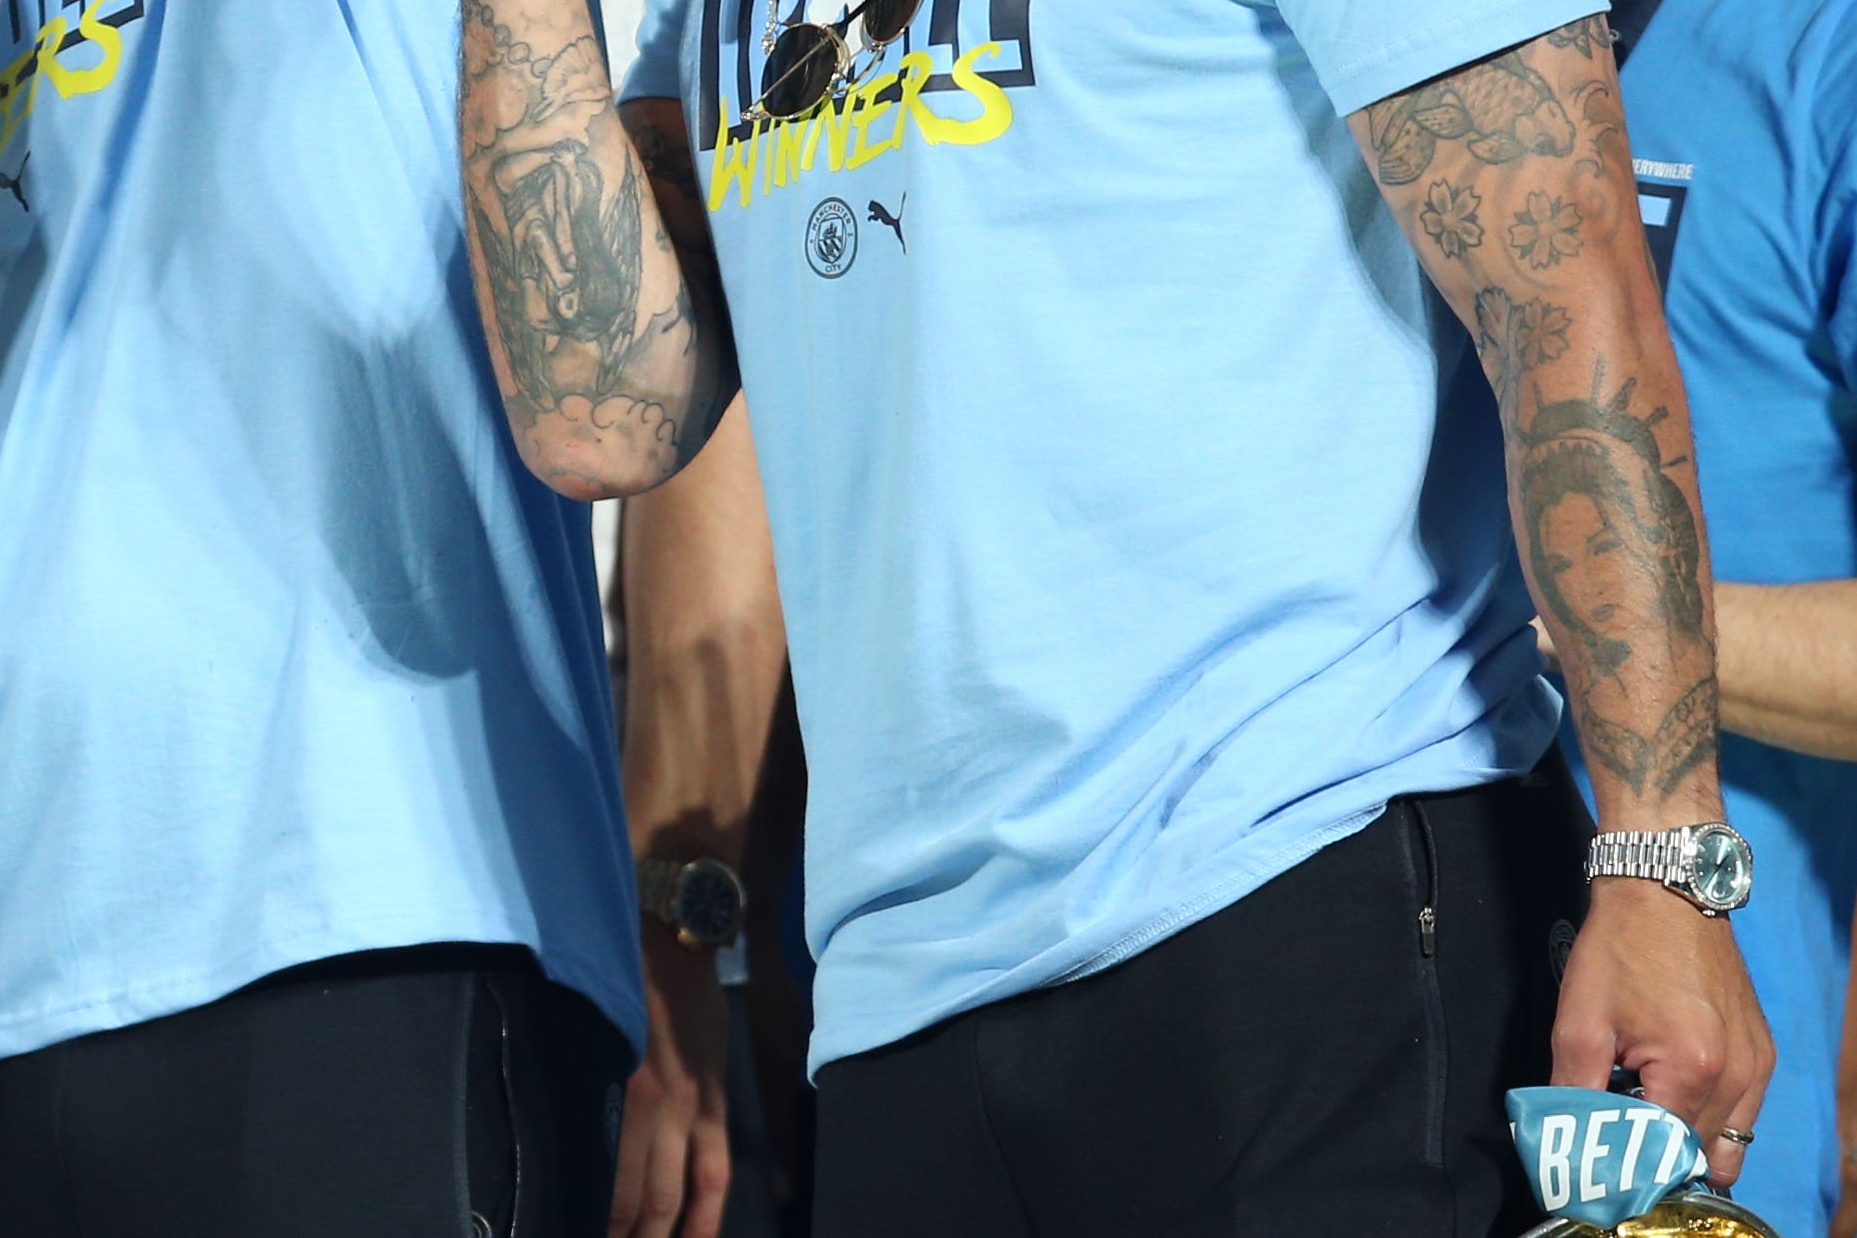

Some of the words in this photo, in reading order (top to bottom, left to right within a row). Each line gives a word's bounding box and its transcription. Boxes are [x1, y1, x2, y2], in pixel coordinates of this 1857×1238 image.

[707, 41, 1013, 211] WINNERS
[811, 203, 852, 232] MANCHESTER
[824, 263, 842, 273] CITY
